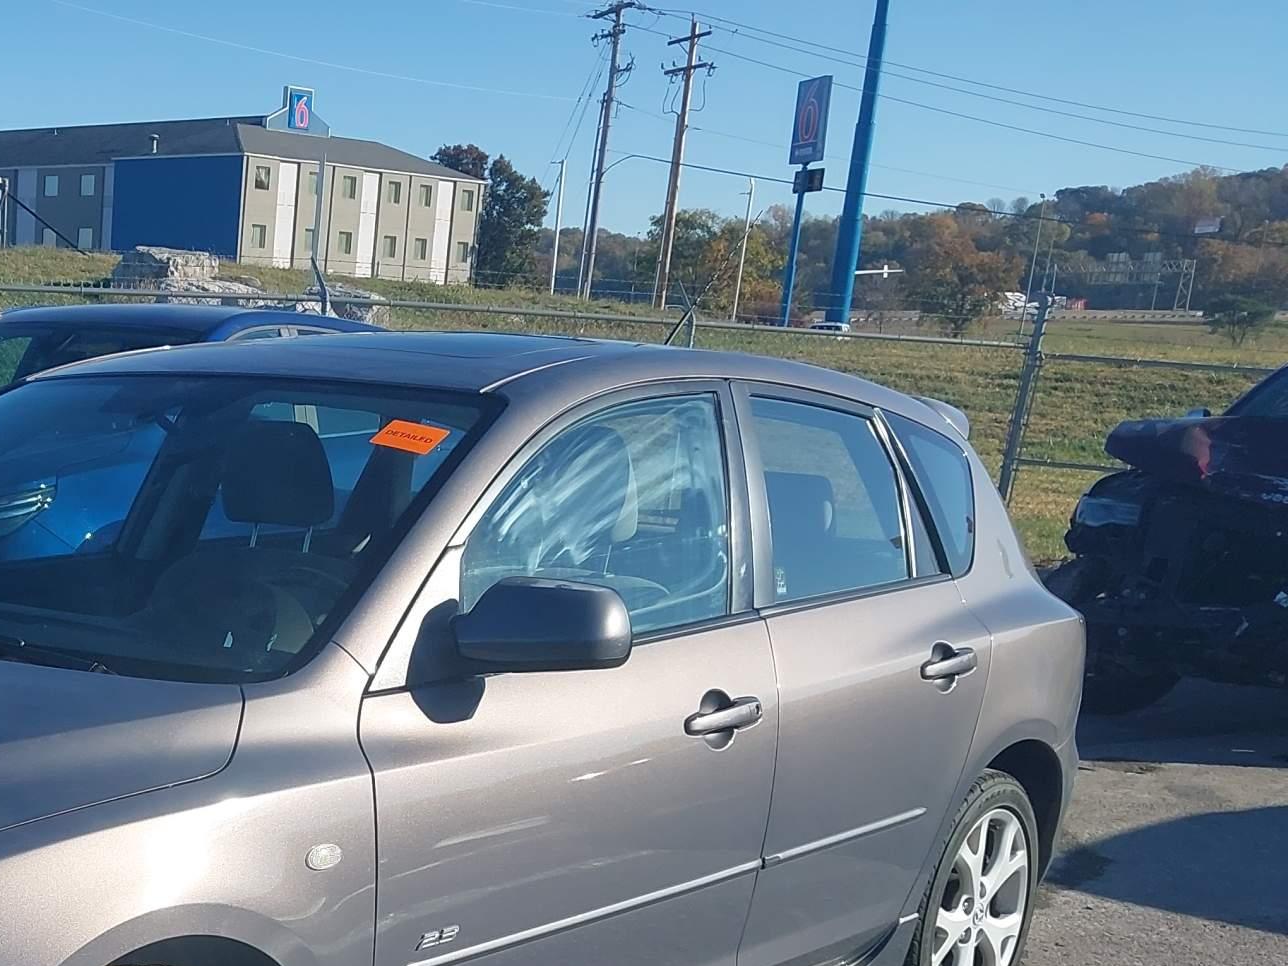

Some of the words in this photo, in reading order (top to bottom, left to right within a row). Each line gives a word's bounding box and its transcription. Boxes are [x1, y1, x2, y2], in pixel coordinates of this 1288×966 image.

[295, 96, 309, 128] 6
[798, 80, 819, 142] 6
[384, 429, 433, 444] DETAILED
